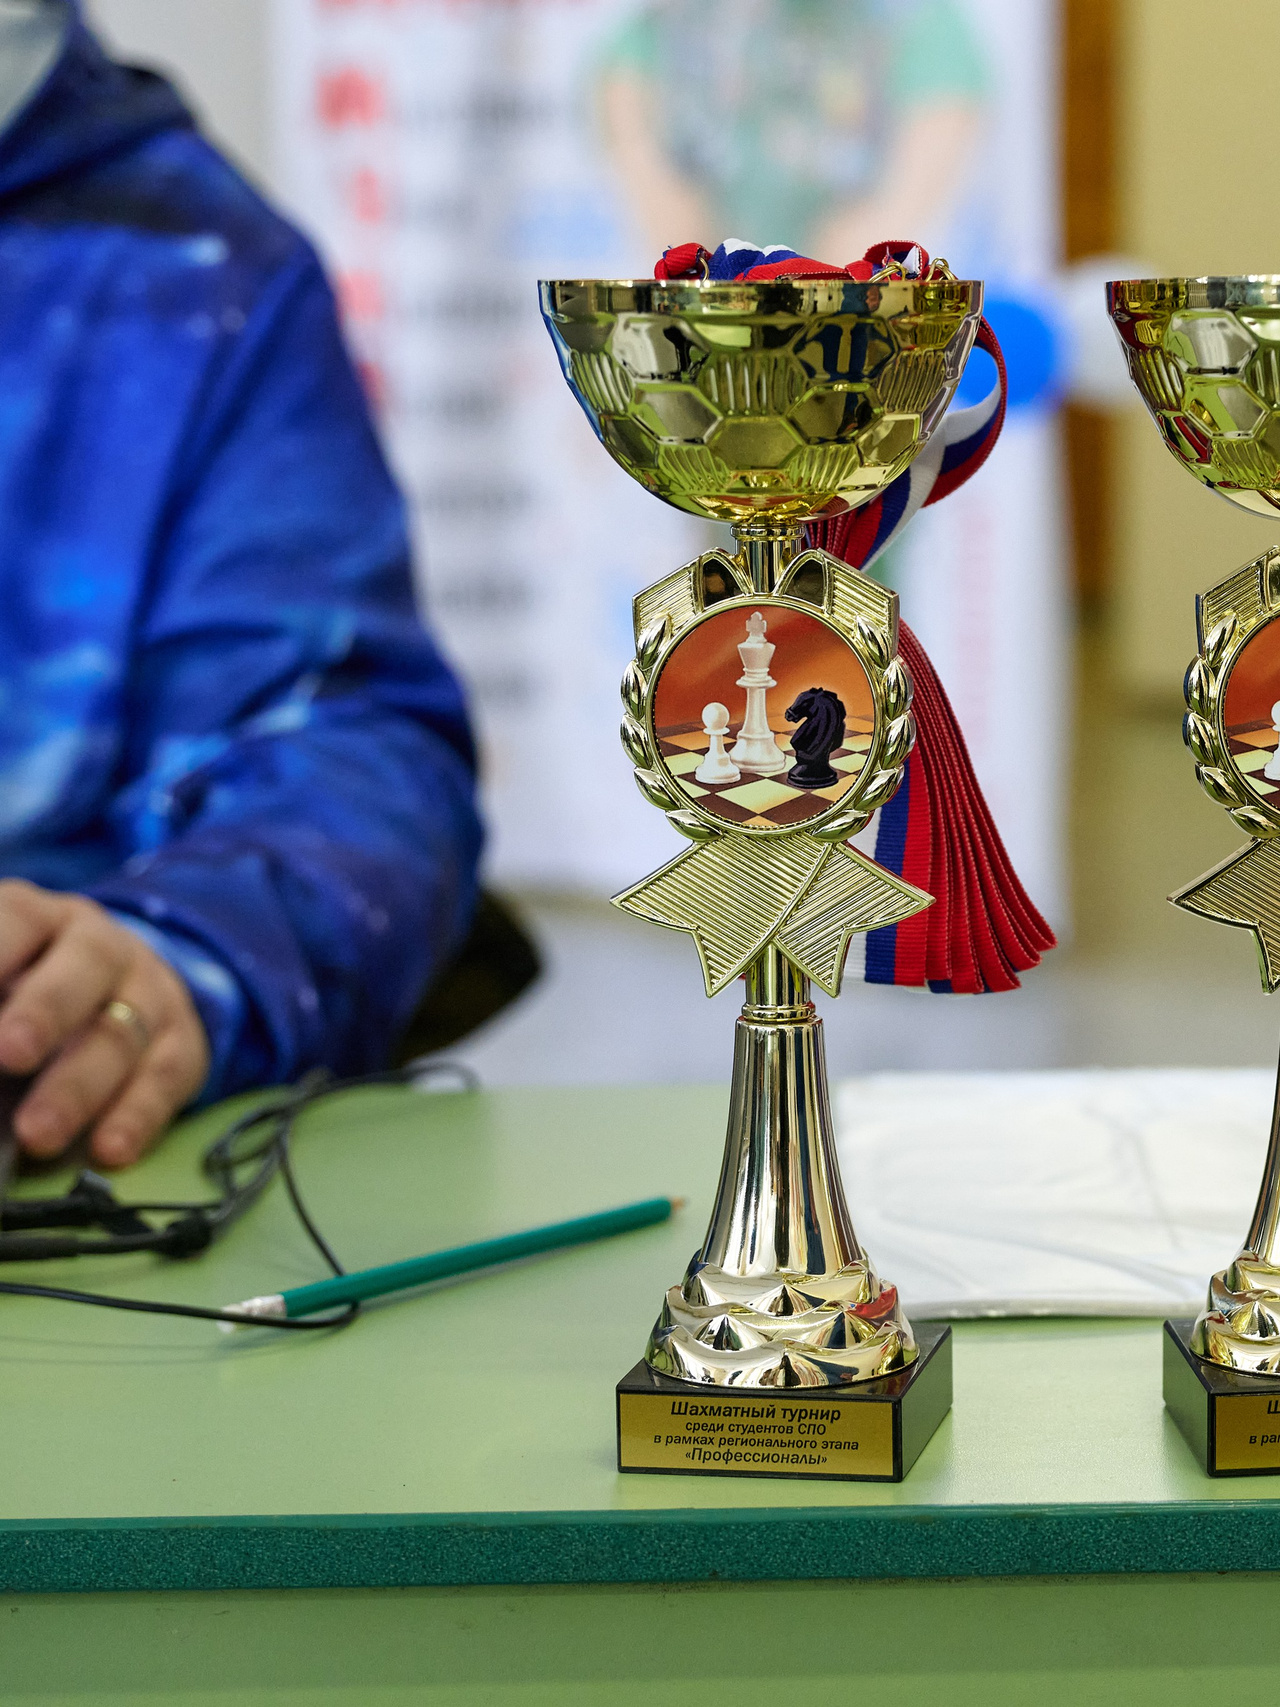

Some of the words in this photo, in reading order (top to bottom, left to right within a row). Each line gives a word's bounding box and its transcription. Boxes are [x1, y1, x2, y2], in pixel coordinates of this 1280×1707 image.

[671, 1401, 775, 1418] Шахматный
[781, 1407, 841, 1422] турнир
[685, 1421, 724, 1433] среди
[728, 1423, 793, 1435] студентов
[798, 1423, 826, 1435] СПО
[654, 1435, 661, 1443] в
[665, 1435, 715, 1446] рамках
[718, 1437, 817, 1449] регионального
[821, 1441, 859, 1450] этапа
[1249, 1434, 1257, 1444] в
[685, 1448, 827, 1465] «Профессионалы»
